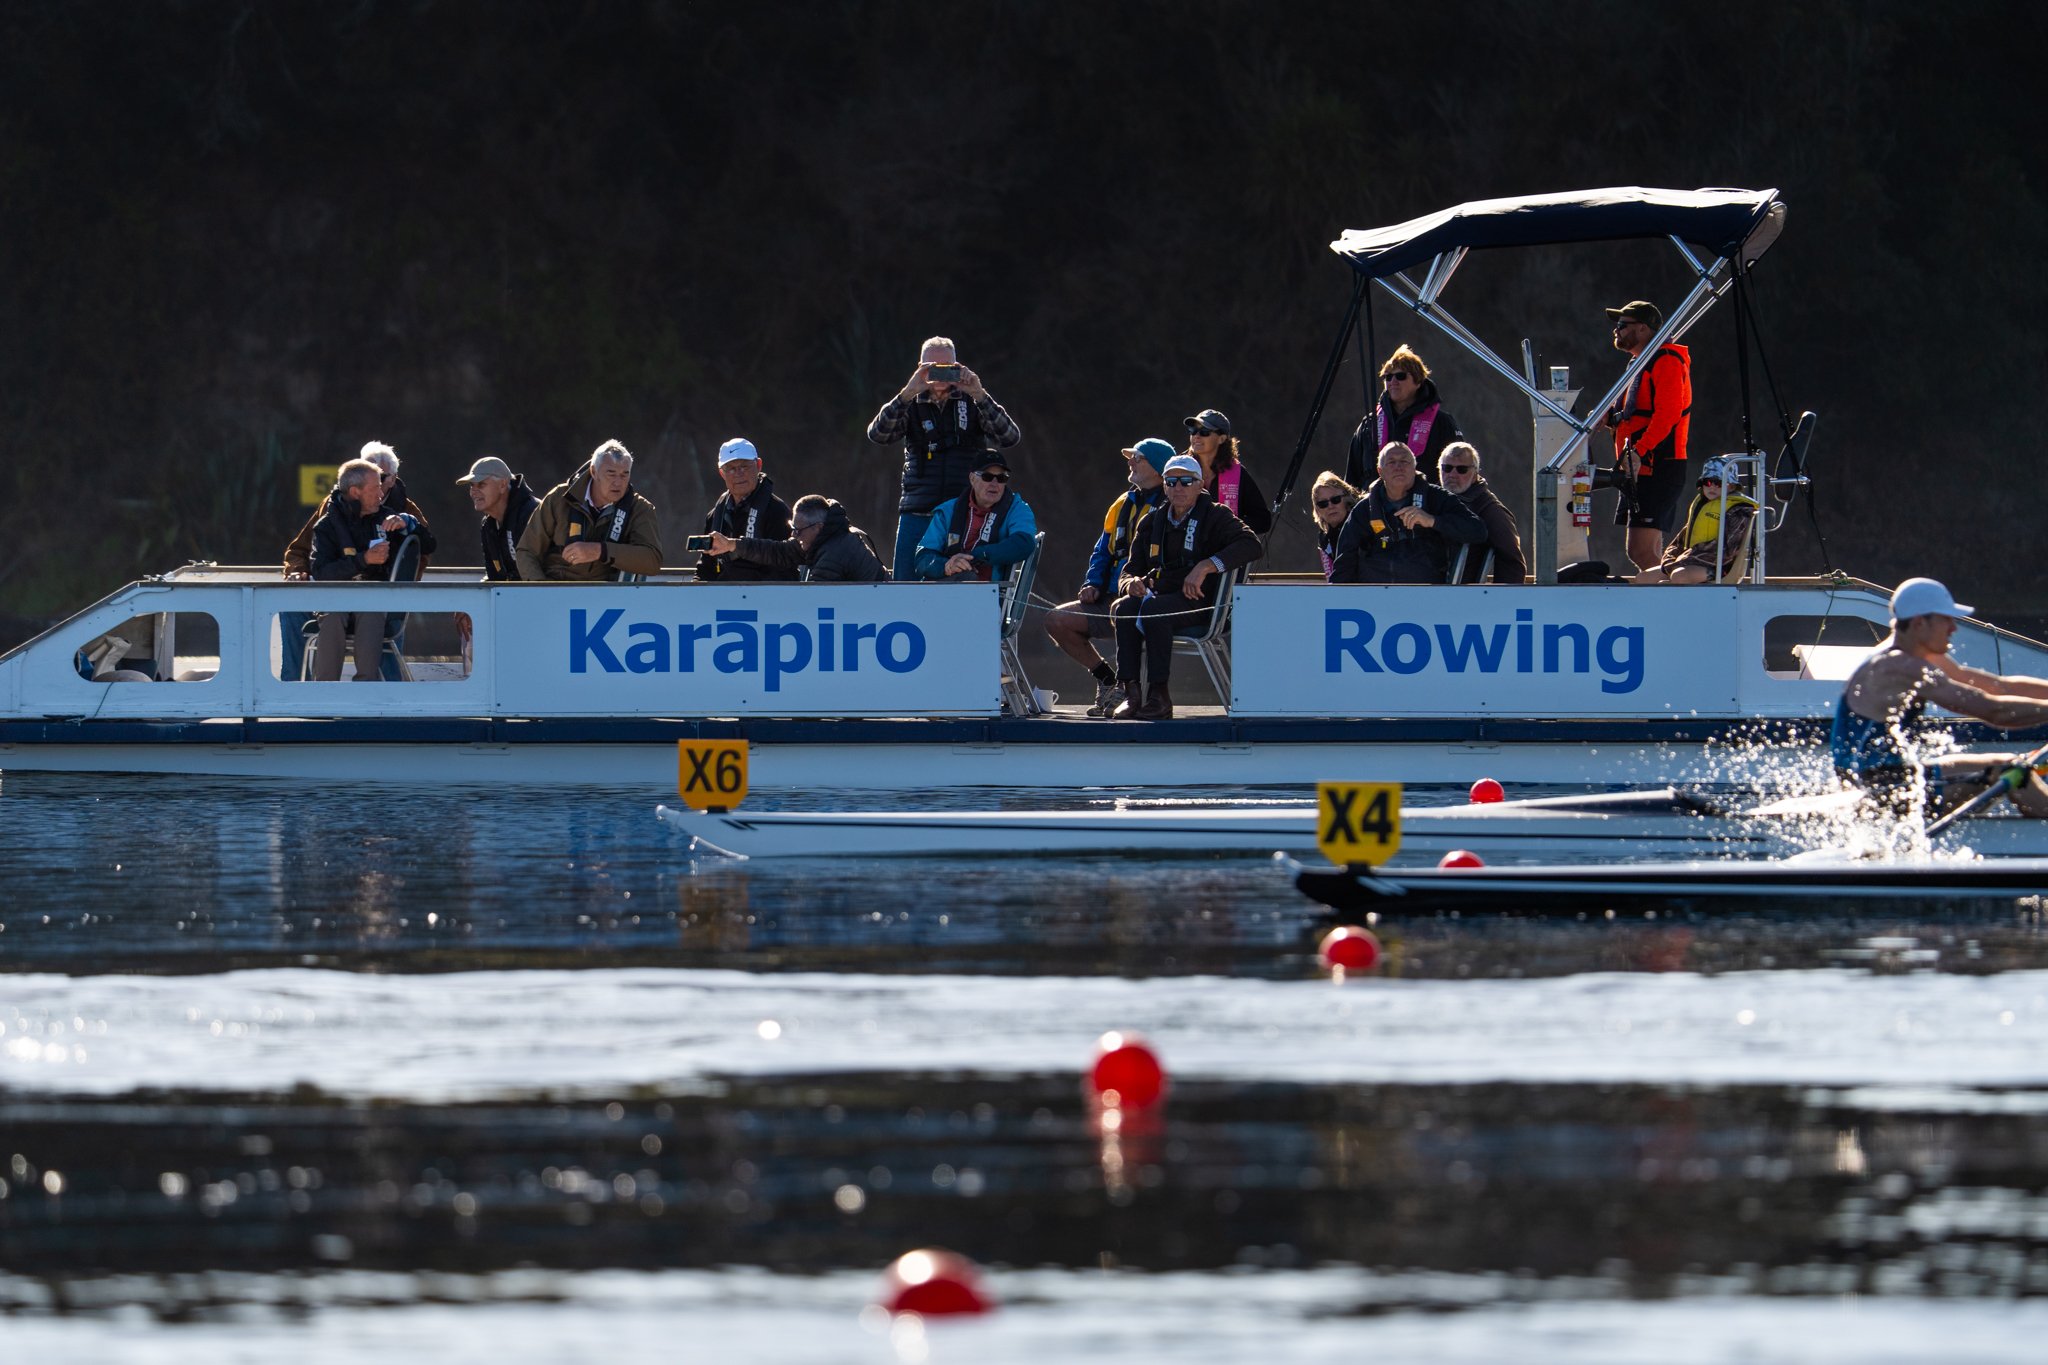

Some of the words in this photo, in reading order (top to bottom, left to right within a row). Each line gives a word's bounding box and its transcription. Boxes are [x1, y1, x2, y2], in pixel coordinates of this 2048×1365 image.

[958, 401, 967, 430] EDGE
[610, 509, 626, 541] EDGE
[746, 508, 757, 538] EDGE
[981, 512, 997, 542] EDGE
[1184, 519, 1197, 551] EDGE
[570, 608, 926, 692] Karāpiro
[1325, 609, 1644, 694] Rowing
[685, 748, 742, 793] X6
[1323, 789, 1393, 843] X4
